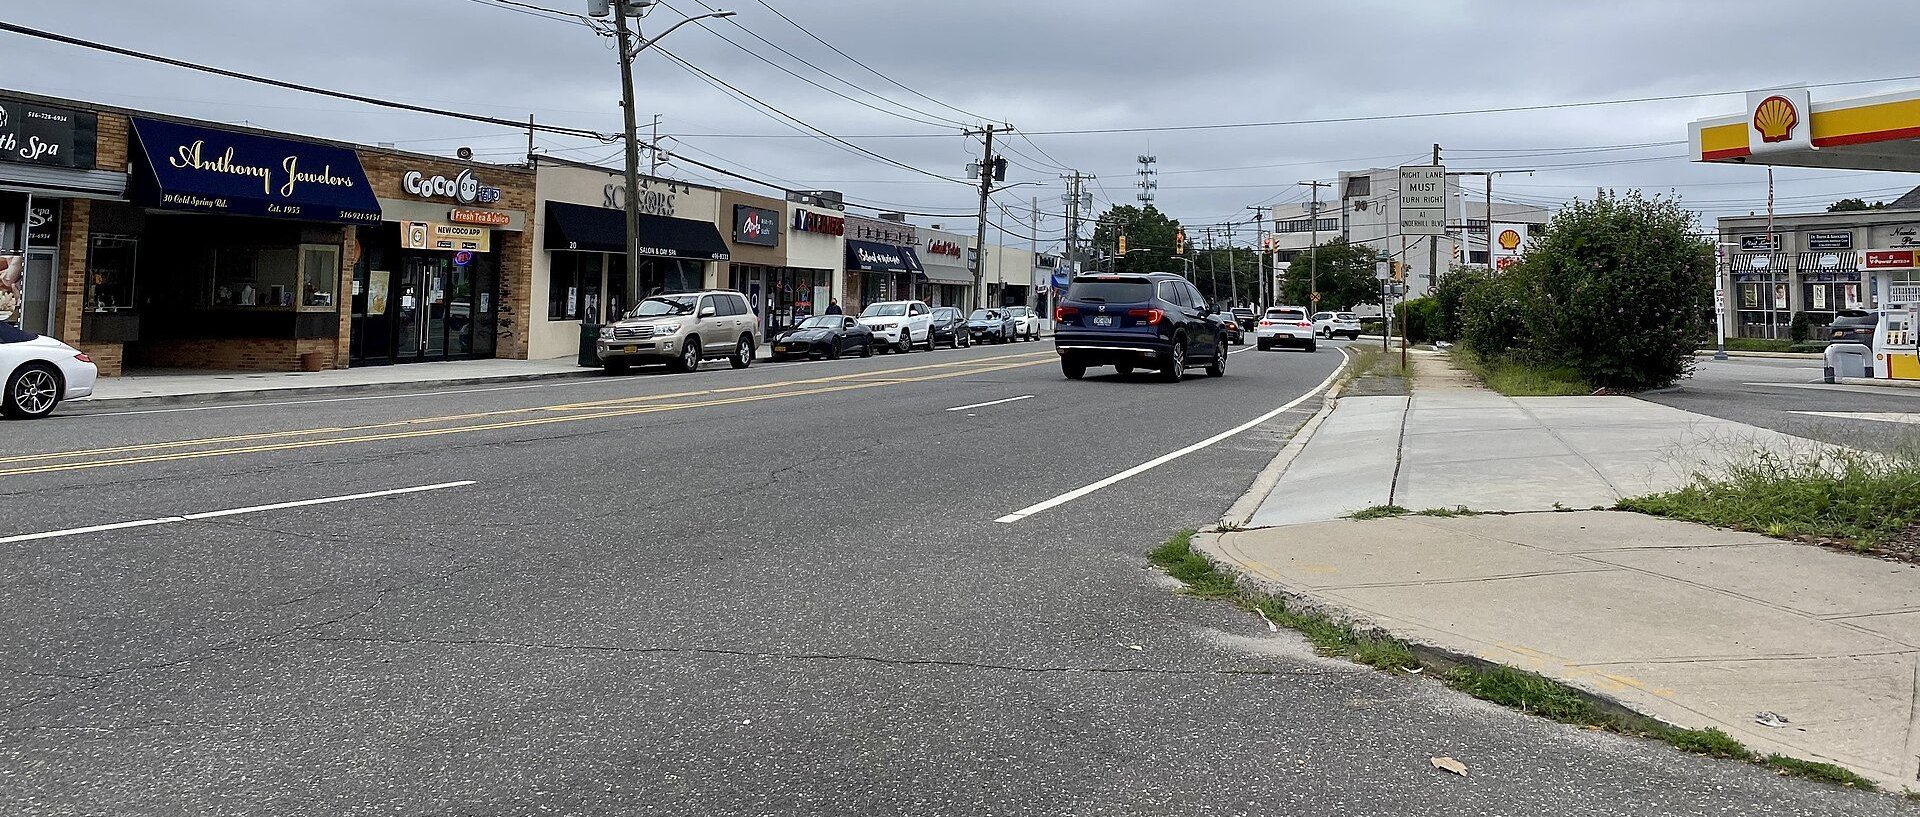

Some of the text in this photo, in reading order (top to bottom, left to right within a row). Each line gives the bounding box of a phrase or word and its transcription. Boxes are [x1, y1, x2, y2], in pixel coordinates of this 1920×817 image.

[19, 135, 59, 160] Spa
[169, 140, 354, 197] Anthony Jewelers
[1401, 171, 1420, 179] RIGHT
[1409, 183, 1436, 192] MUST
[162, 193, 228, 209] 30 Cold Spring Rd.
[1423, 196, 1443, 204] RIGHT
[268, 203, 301, 214] Est. 1955
[455, 211, 509, 224] Fresh Tea & Juice
[437, 226, 452, 234] NEW
[451, 227, 468, 235] COCO
[569, 241, 577, 249] 20
[639, 246, 655, 255] SALON
[660, 248, 668, 256] DAY
